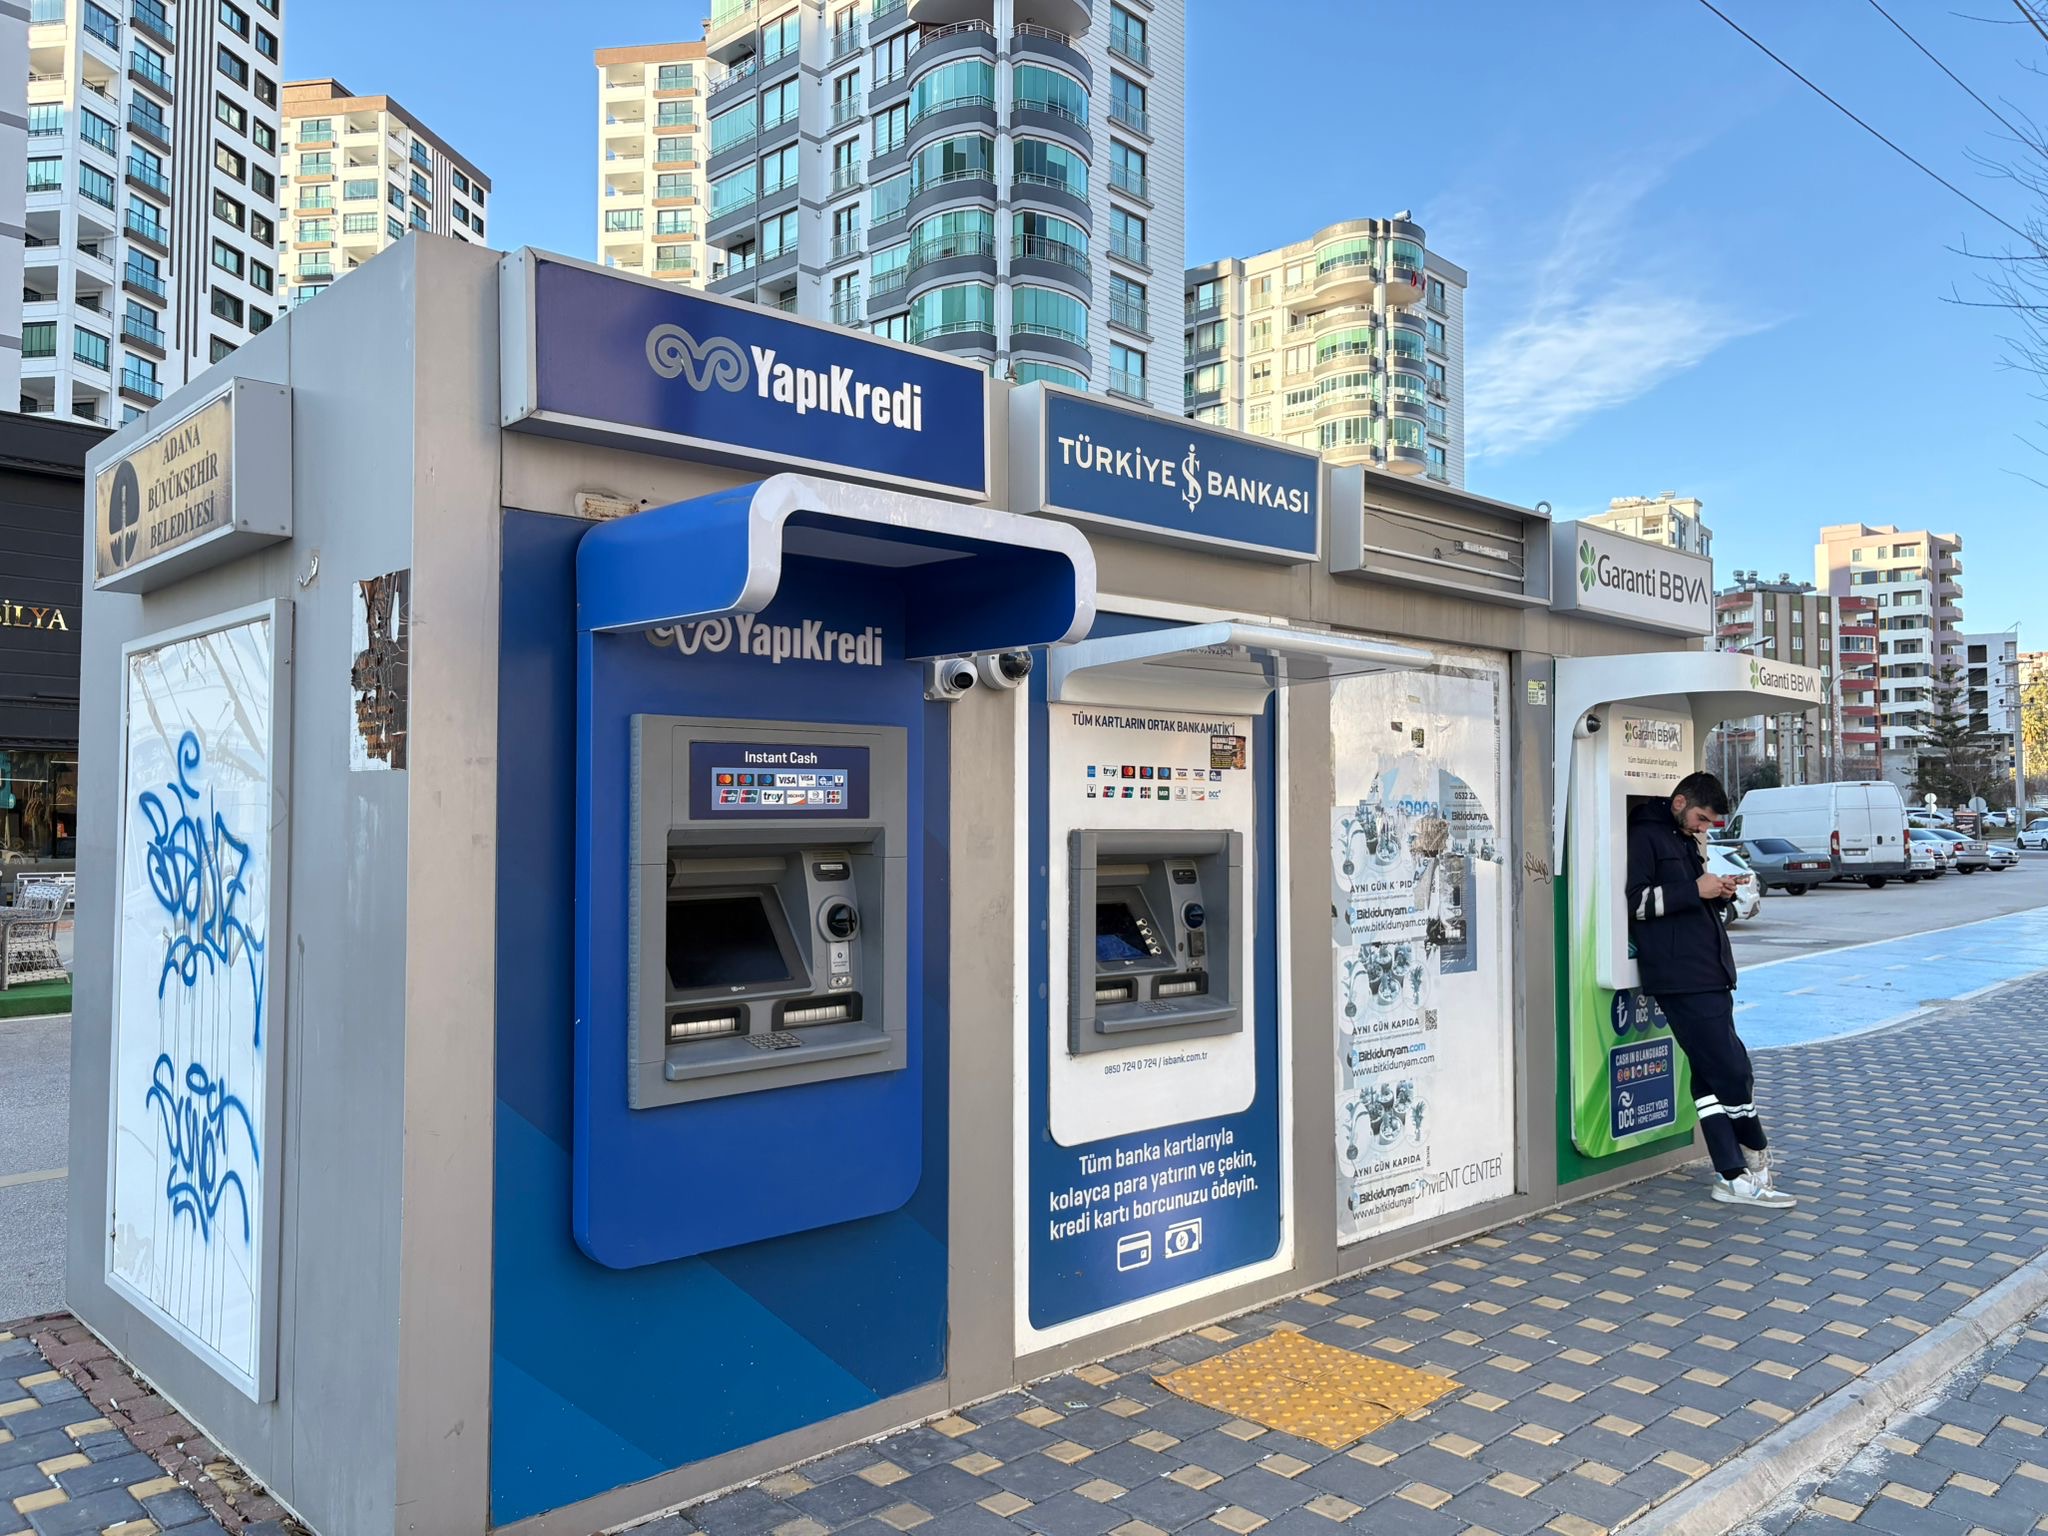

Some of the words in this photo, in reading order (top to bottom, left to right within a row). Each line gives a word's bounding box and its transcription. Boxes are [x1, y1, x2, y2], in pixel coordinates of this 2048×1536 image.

[750, 344, 922, 432] YapıKredi
[162, 422, 201, 466] ADANA
[148, 449, 219, 513] BÜYÜKŞEHİR
[1058, 433, 1176, 488] TÜRKİYE
[1207, 470, 1309, 514] BANKASI
[150, 490, 215, 549] BELEDİYESİ
[1597, 554, 1656, 597] Garanti
[1659, 570, 1708, 605] BBVA
[0, 599, 69, 631] İLYA
[735, 613, 883, 666] YapıKredi
[1759, 666, 1789, 691] Garanti
[1790, 673, 1816, 693] BBVA
[1072, 711, 1093, 727] TÜM
[1094, 713, 1146, 730] KARTLARIN
[1147, 719, 1176, 732] ORTAK
[1632, 725, 1657, 742] Garanti
[745, 751, 787, 763] Instant
[789, 751, 818, 764] Cash
[779, 776, 796, 785] VISA
[1103, 767, 1117, 777] troy
[763, 791, 783, 803] troy
[1350, 883, 1369, 894] AYNI
[1370, 880, 1387, 892] GÜN
[1635, 1007, 1649, 1023] DCC
[1352, 1025, 1371, 1037] AYNI
[1372, 1021, 1389, 1033] GÜN
[1391, 1017, 1420, 1030] KAPIDA
[1104, 1064, 1121, 1075] 0850
[1122, 1061, 1136, 1072] 724
[1137, 1060, 1143, 1070] 0
[1144, 1058, 1158, 1069] 724
[1163, 1051, 1208, 1066] isbank.com.tr
[1358, 1042, 1426, 1063] Bitkidunyam.com
[1615, 1052, 1630, 1067] CASH
[1629, 1051, 1636, 1064] IN
[1640, 1045, 1669, 1061] LANGUAGES
[1352, 1054, 1435, 1077] www.bitkidunyam.com
[1618, 1107, 1635, 1130] DCC
[1637, 1102, 1655, 1116] SELECT
[1655, 1098, 1669, 1113] YOUR
[1637, 1113, 1649, 1125] HOME
[1648, 1109, 1669, 1121] CURRENCY
[1079, 1153, 1112, 1177] Tüm
[1115, 1144, 1161, 1169] banka
[1164, 1127, 1234, 1158] kartlarıyla
[1353, 1167, 1372, 1179] AYNI
[1374, 1161, 1391, 1173] GÜN
[1392, 1154, 1421, 1169] KAPIDA
[1461, 1156, 1502, 1186] CENTER
[1050, 1185, 1110, 1212] kolayca
[1114, 1175, 1148, 1201] para
[1151, 1164, 1197, 1193] yatırın
[1199, 1160, 1216, 1176] ve
[1218, 1149, 1257, 1178] çekin,
[1050, 1211, 1090, 1241] kredi
[1094, 1206, 1130, 1230] kartı
[1133, 1188, 1208, 1219] borcunuzu
[1211, 1175, 1259, 1201] ödeyin.
